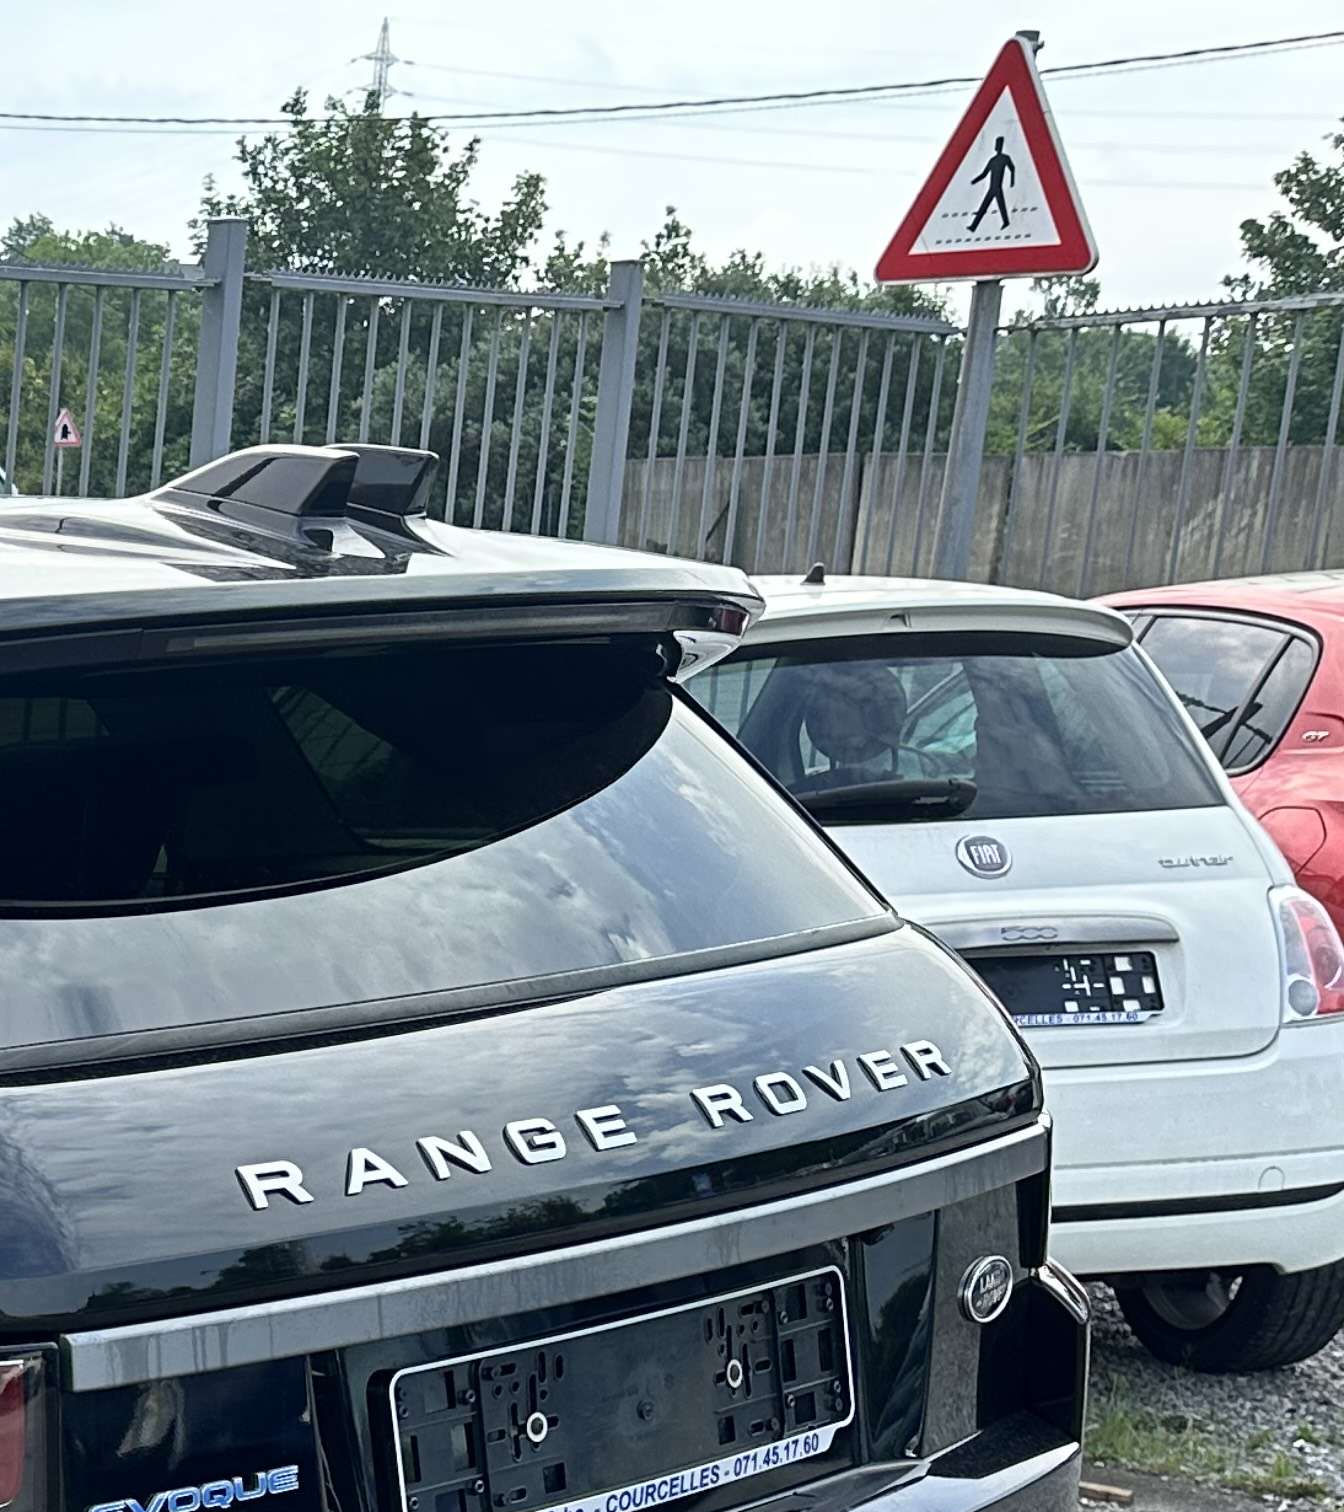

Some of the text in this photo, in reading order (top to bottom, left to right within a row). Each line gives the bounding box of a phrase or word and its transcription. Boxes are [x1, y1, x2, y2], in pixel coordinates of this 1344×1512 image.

[969, 844, 1001, 865] FIAT
[1001, 926, 1058, 941] 500
[235, 1039, 952, 1210] RANGE ROVER
[733, 1433, 819, 1478] 071.45.17.60
